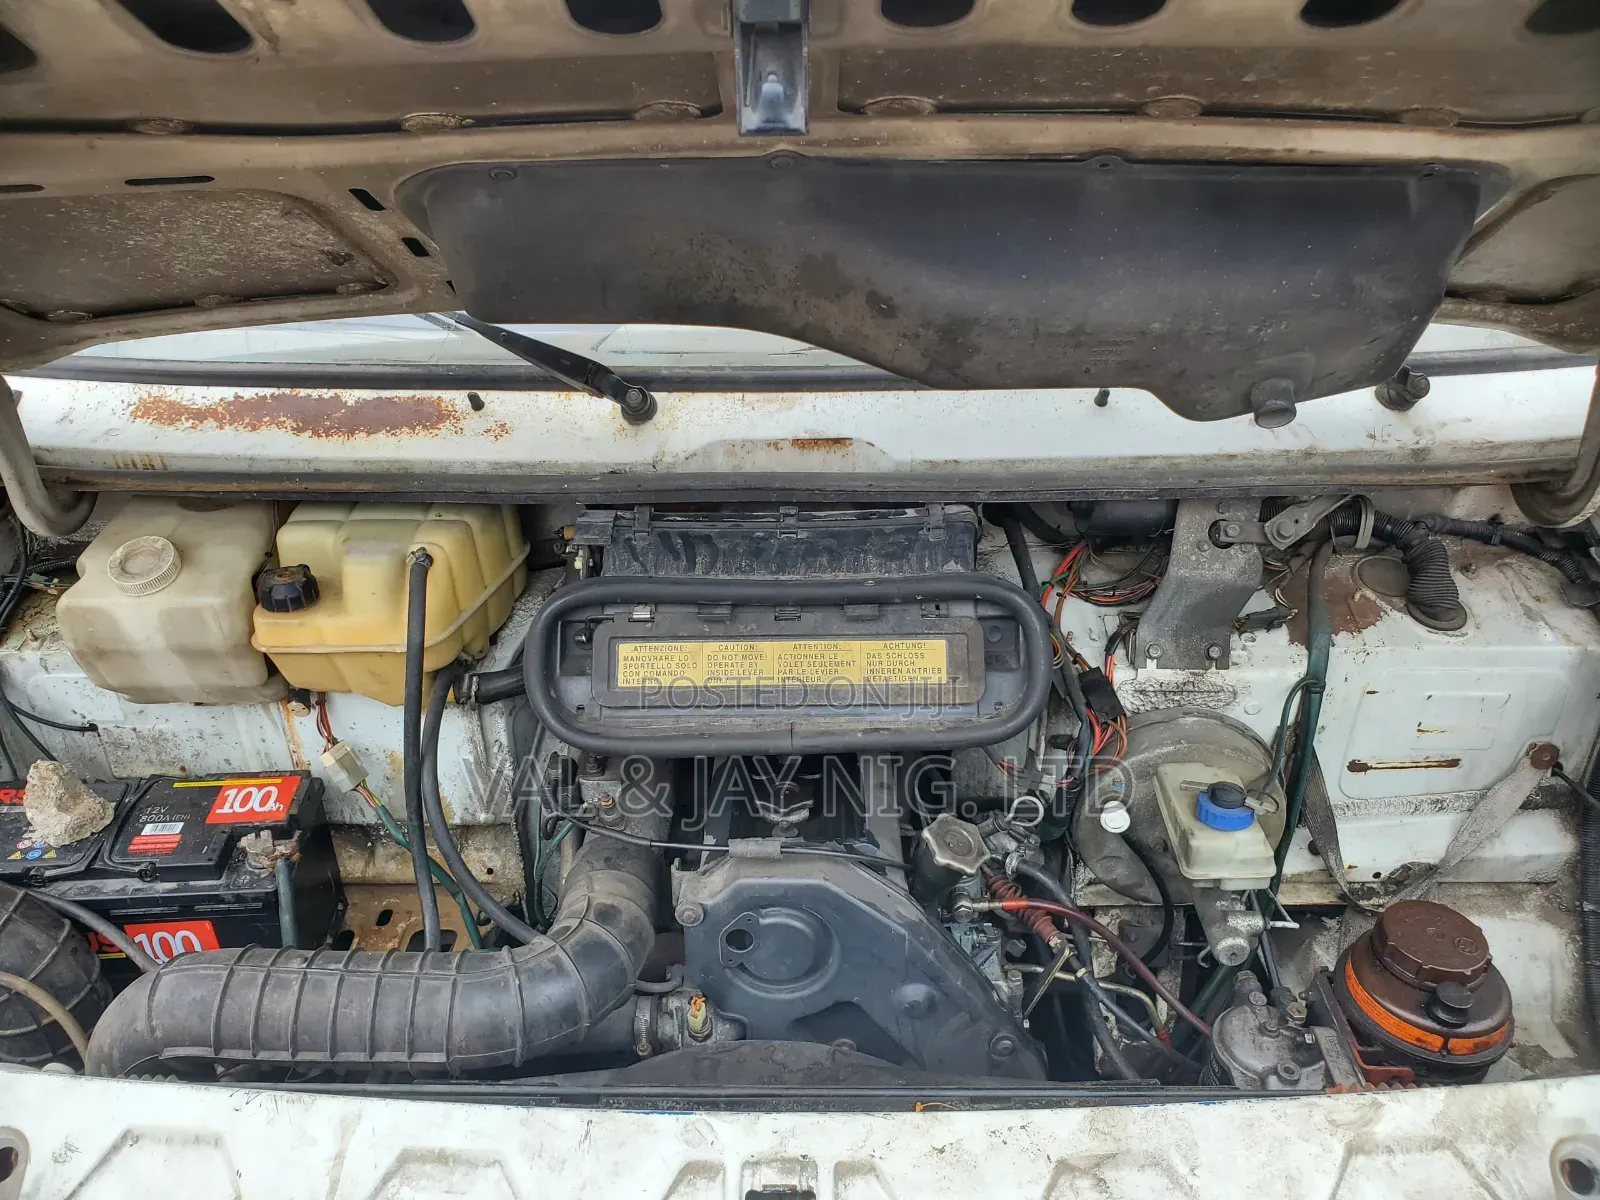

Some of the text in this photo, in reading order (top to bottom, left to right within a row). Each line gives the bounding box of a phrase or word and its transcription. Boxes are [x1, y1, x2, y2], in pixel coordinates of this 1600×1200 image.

[623, 662, 672, 670] SPORTELLO
[777, 660, 804, 668] VOLET
[887, 659, 915, 667] DURCH
[866, 667, 903, 675] INNEREN
[145, 805, 169, 814] 12V
[139, 814, 170, 823] 800A
[133, 929, 203, 965] 100
